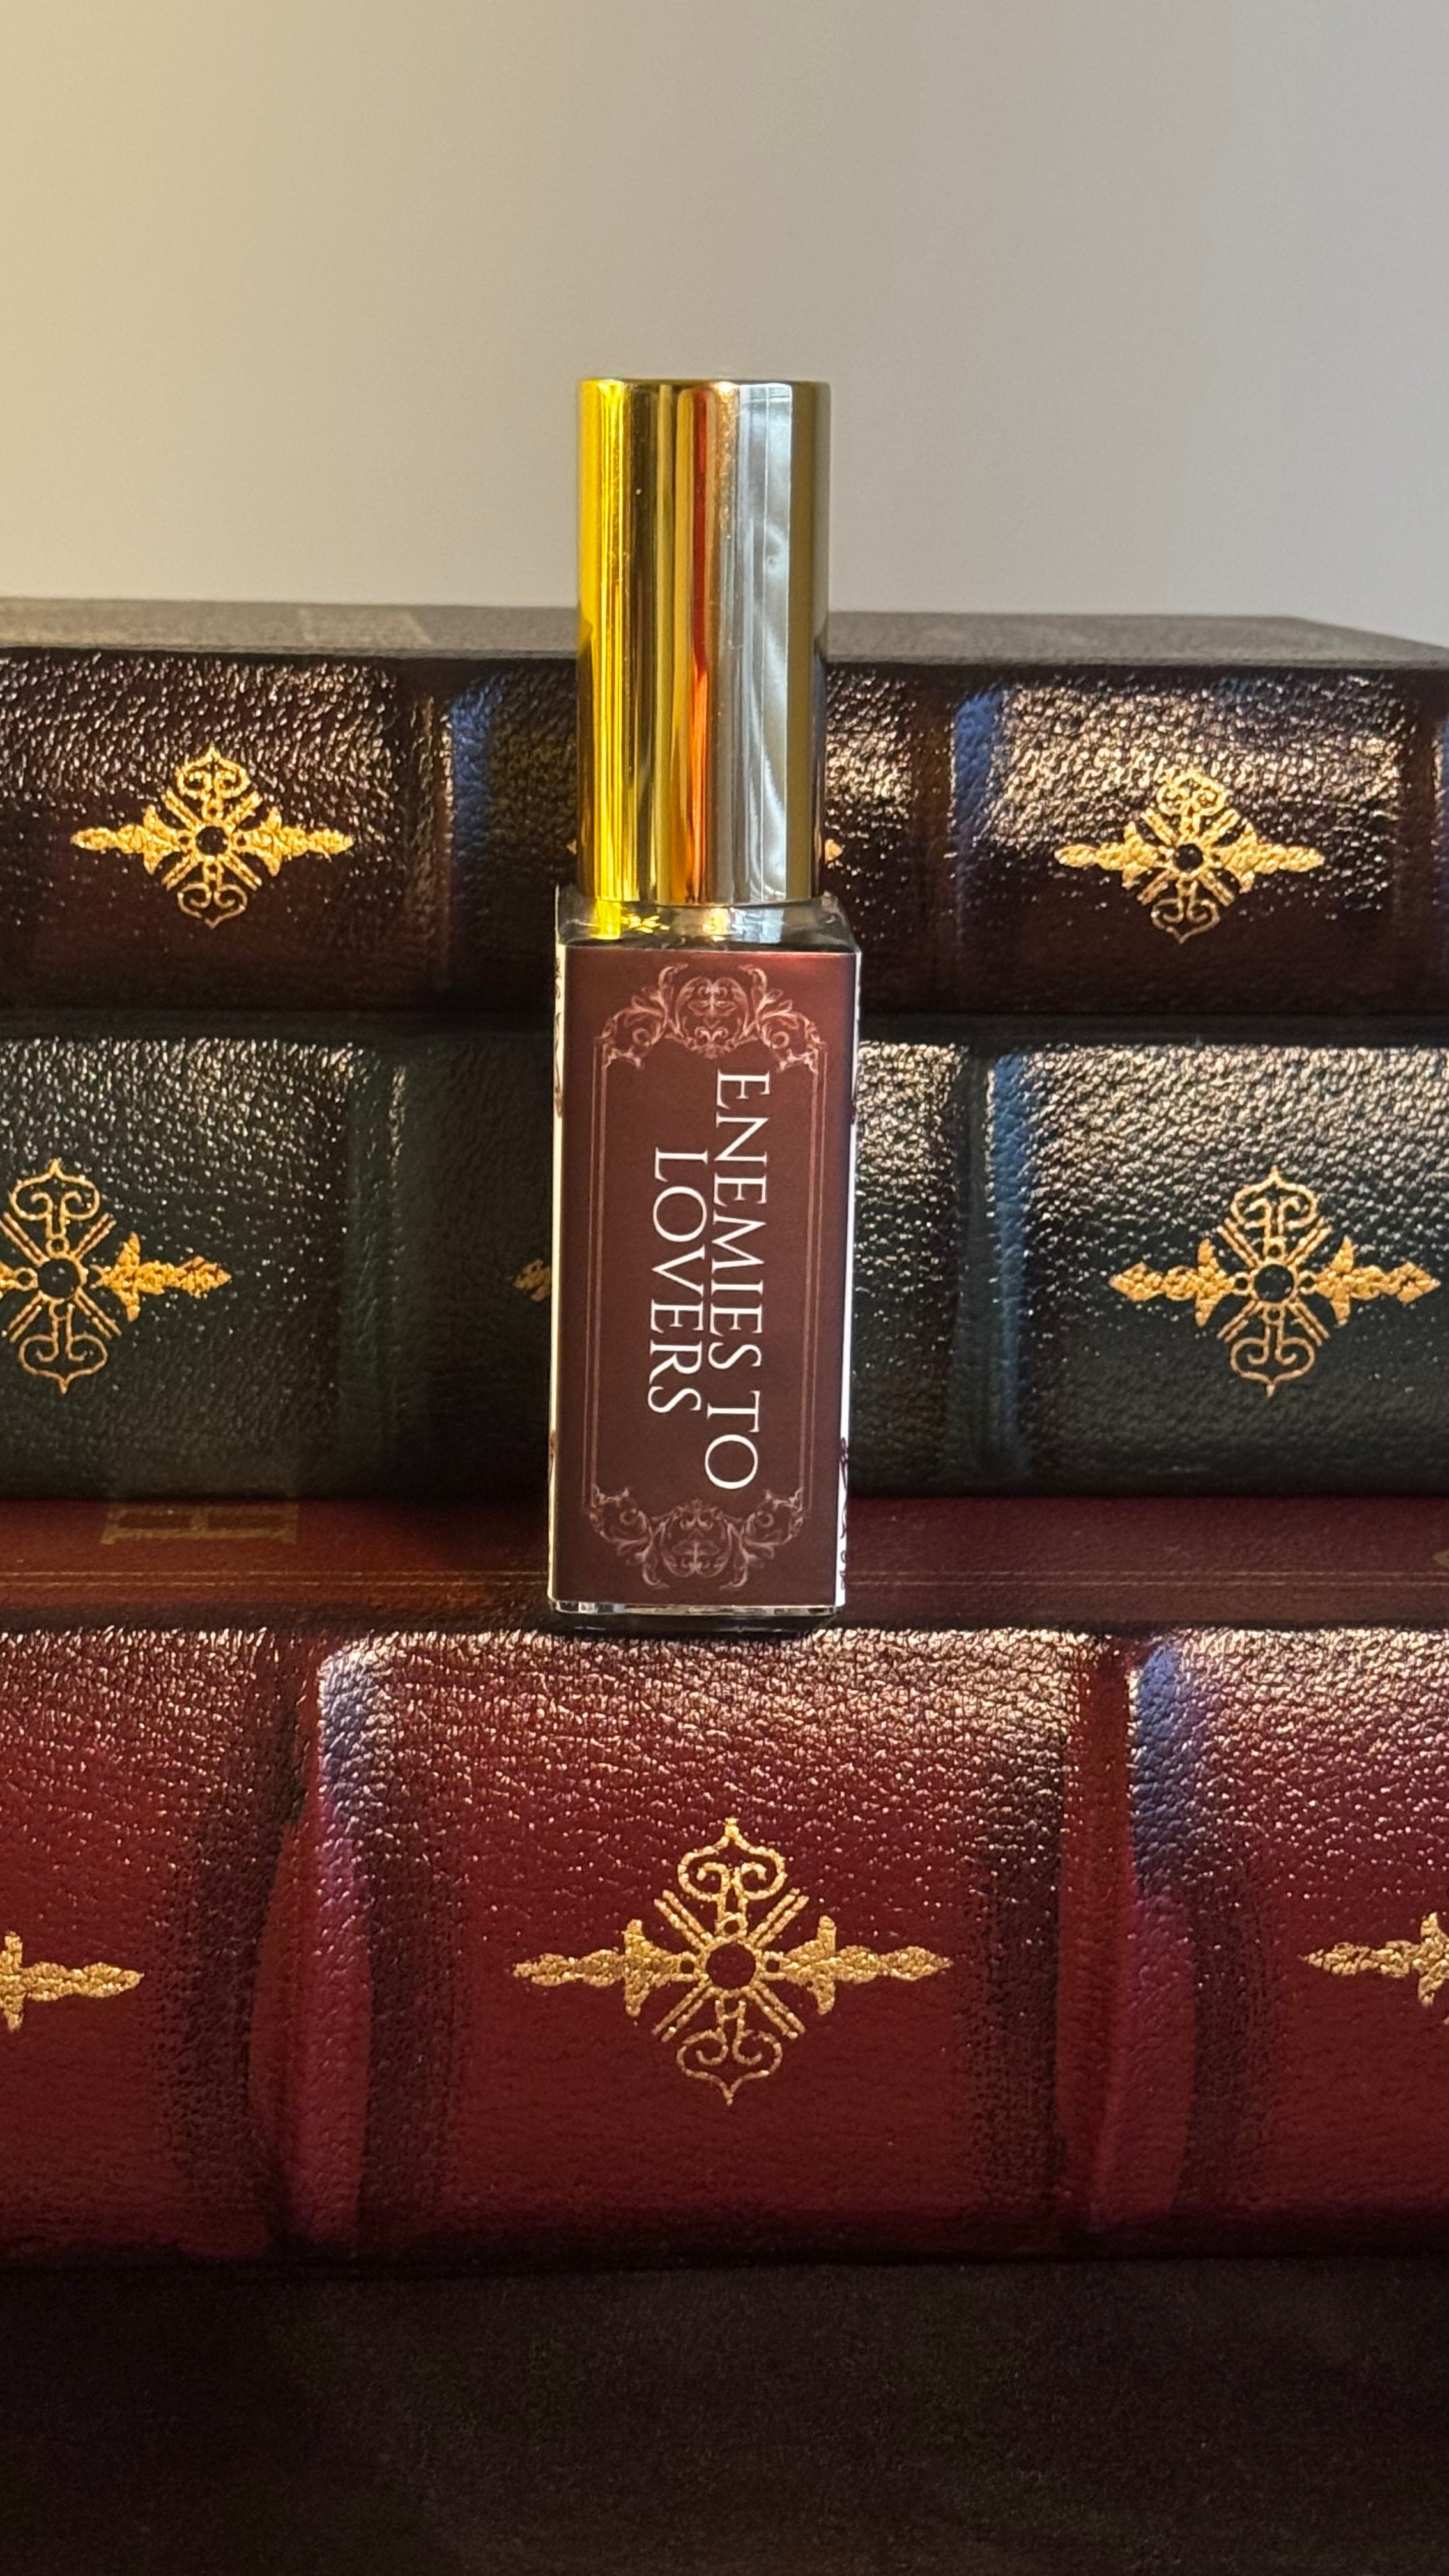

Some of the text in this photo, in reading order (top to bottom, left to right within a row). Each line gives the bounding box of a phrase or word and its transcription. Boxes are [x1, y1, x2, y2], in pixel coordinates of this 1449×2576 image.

[647, 1147, 709, 1413] LOVERS
[705, 1069, 770, 1489] ENEMIES TO
